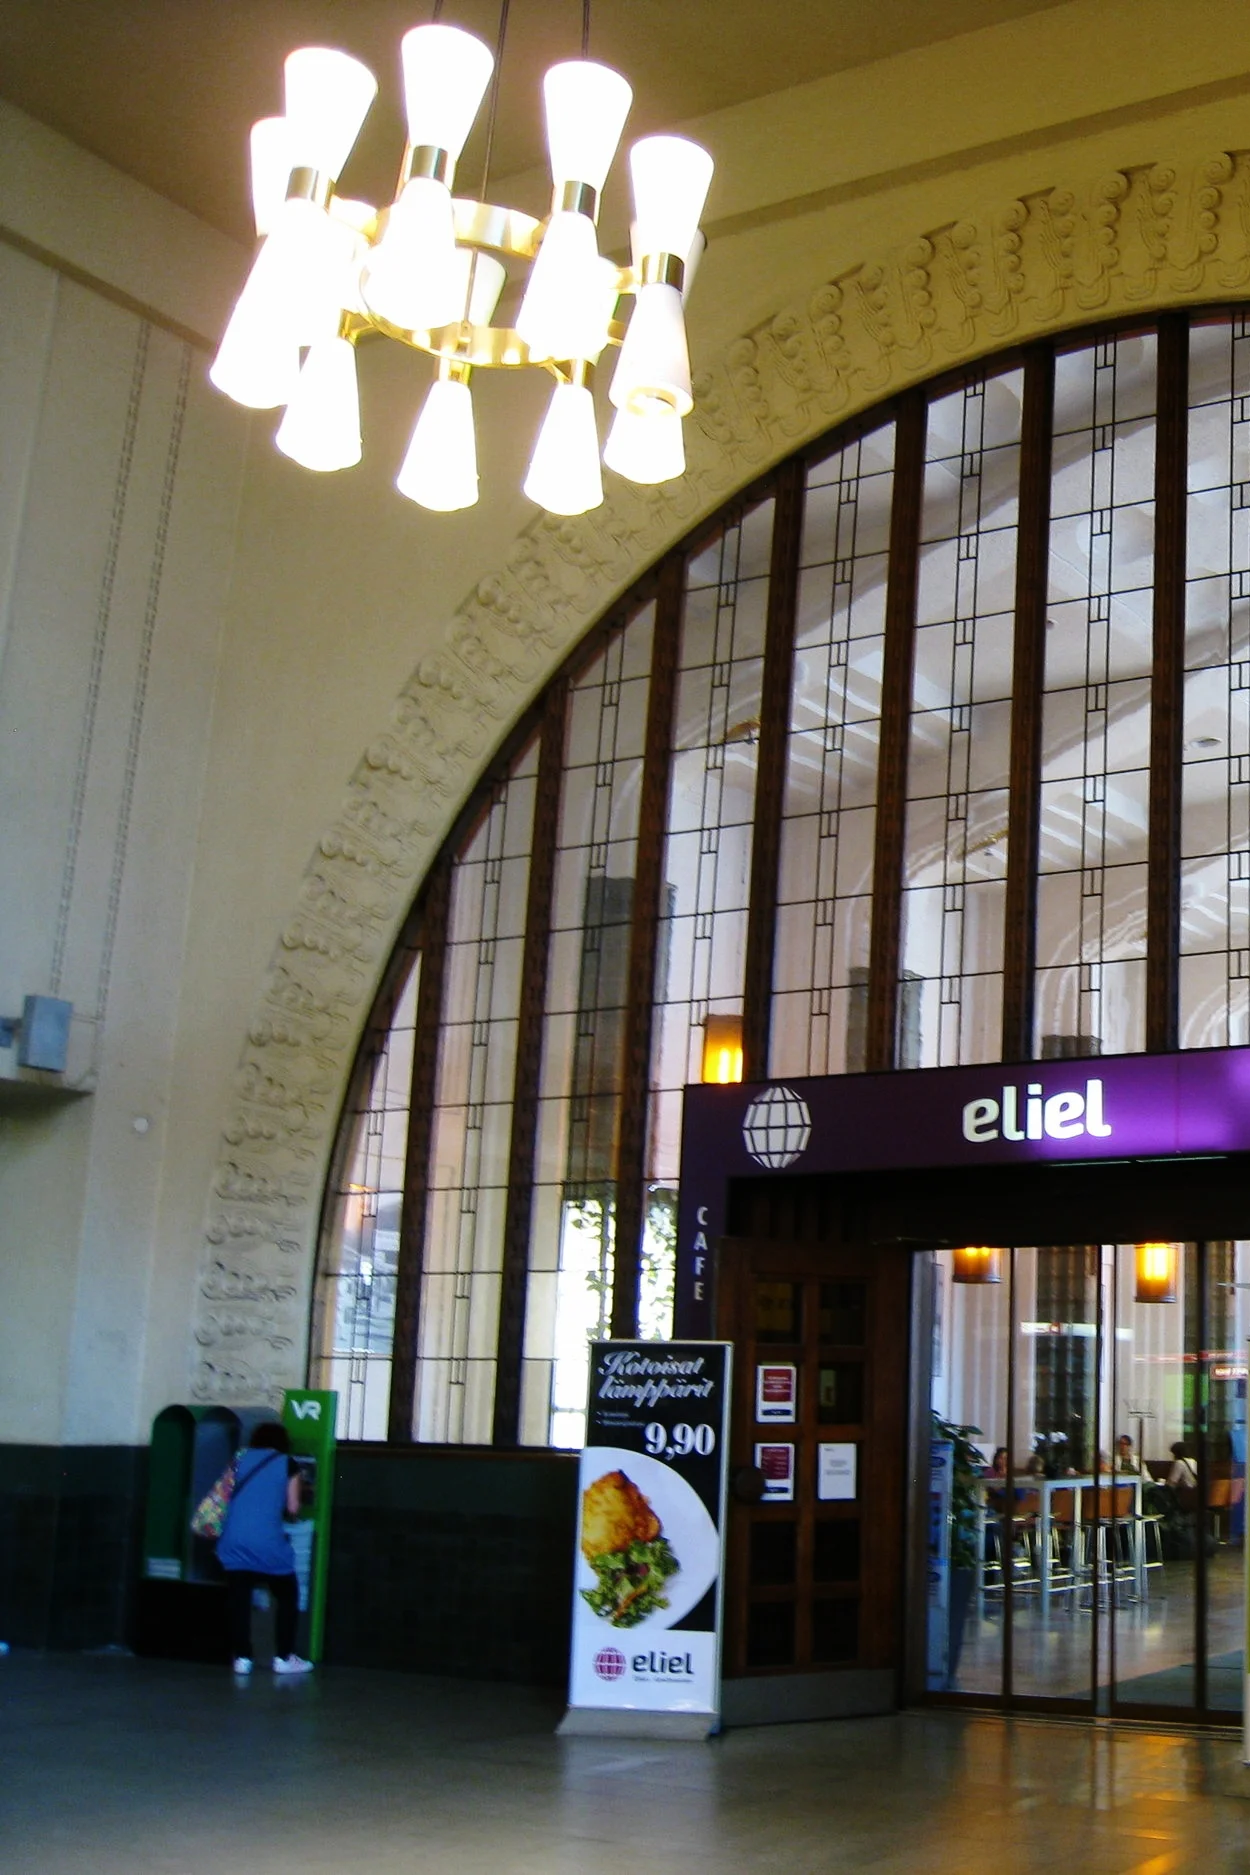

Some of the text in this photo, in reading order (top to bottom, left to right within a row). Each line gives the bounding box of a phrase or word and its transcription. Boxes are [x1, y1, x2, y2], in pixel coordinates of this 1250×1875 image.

[962, 1078, 1113, 1143] eliel
[693, 1205, 709, 1301] CAFE
[290, 1399, 322, 1421] VR
[644, 1421, 716, 1461] 9,90
[632, 1650, 695, 1675] eliel
